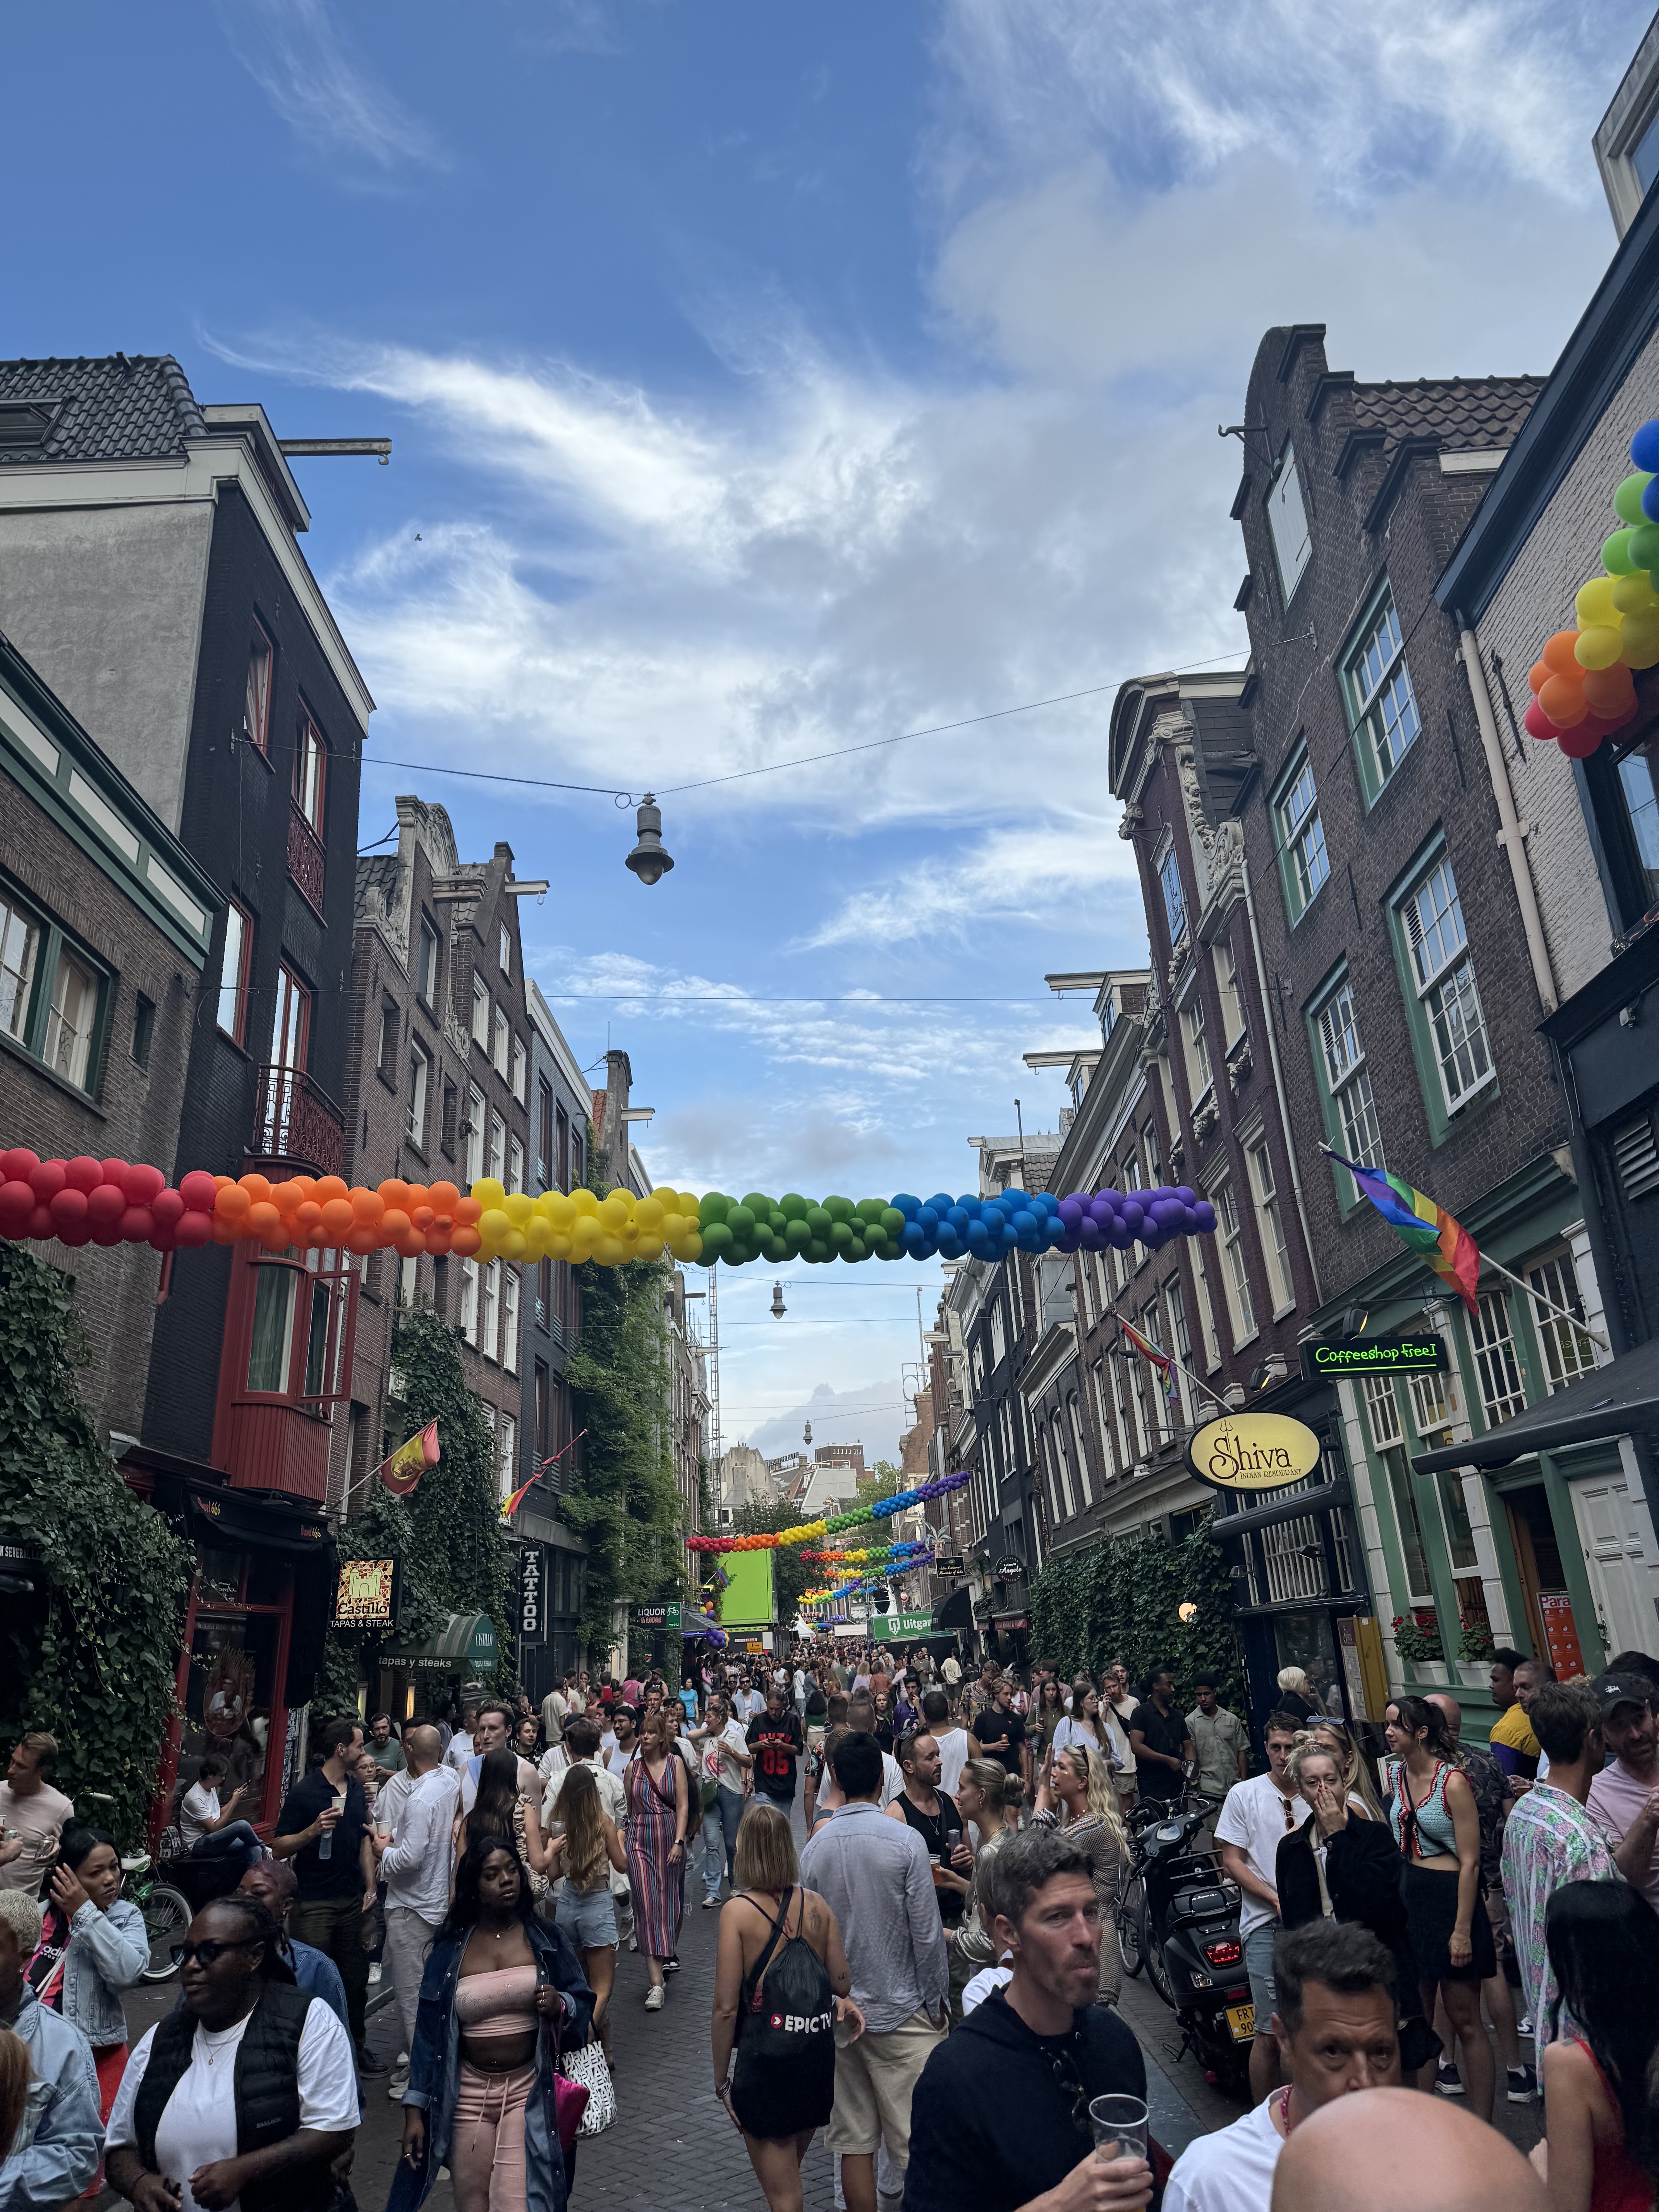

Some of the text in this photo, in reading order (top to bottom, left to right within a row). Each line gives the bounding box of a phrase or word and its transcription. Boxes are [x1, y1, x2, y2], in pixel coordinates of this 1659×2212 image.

[1316, 1345, 1399, 1363] Coffeeshop
[1209, 1435, 1292, 1479] Shiva
[1263, 1468, 1302, 1478] RESTAURANT
[211, 1502, 220, 1516] 666
[312, 1527, 321, 1539] 666
[5, 1546, 30, 1559] SEVERAL
[998, 1565, 1022, 1575] Angelo
[523, 1551, 540, 1632] TATTOO
[337, 1602, 387, 1615] Castillo
[903, 1618, 932, 1630] Uitgan
[476, 1633, 493, 1646] CASTILLO
[378, 1656, 452, 1668] tapas y steaks
[43, 1946, 64, 1957] adi
[1236, 2006, 1254, 2020] FRT
[785, 2011, 831, 2033] EPIC TV
